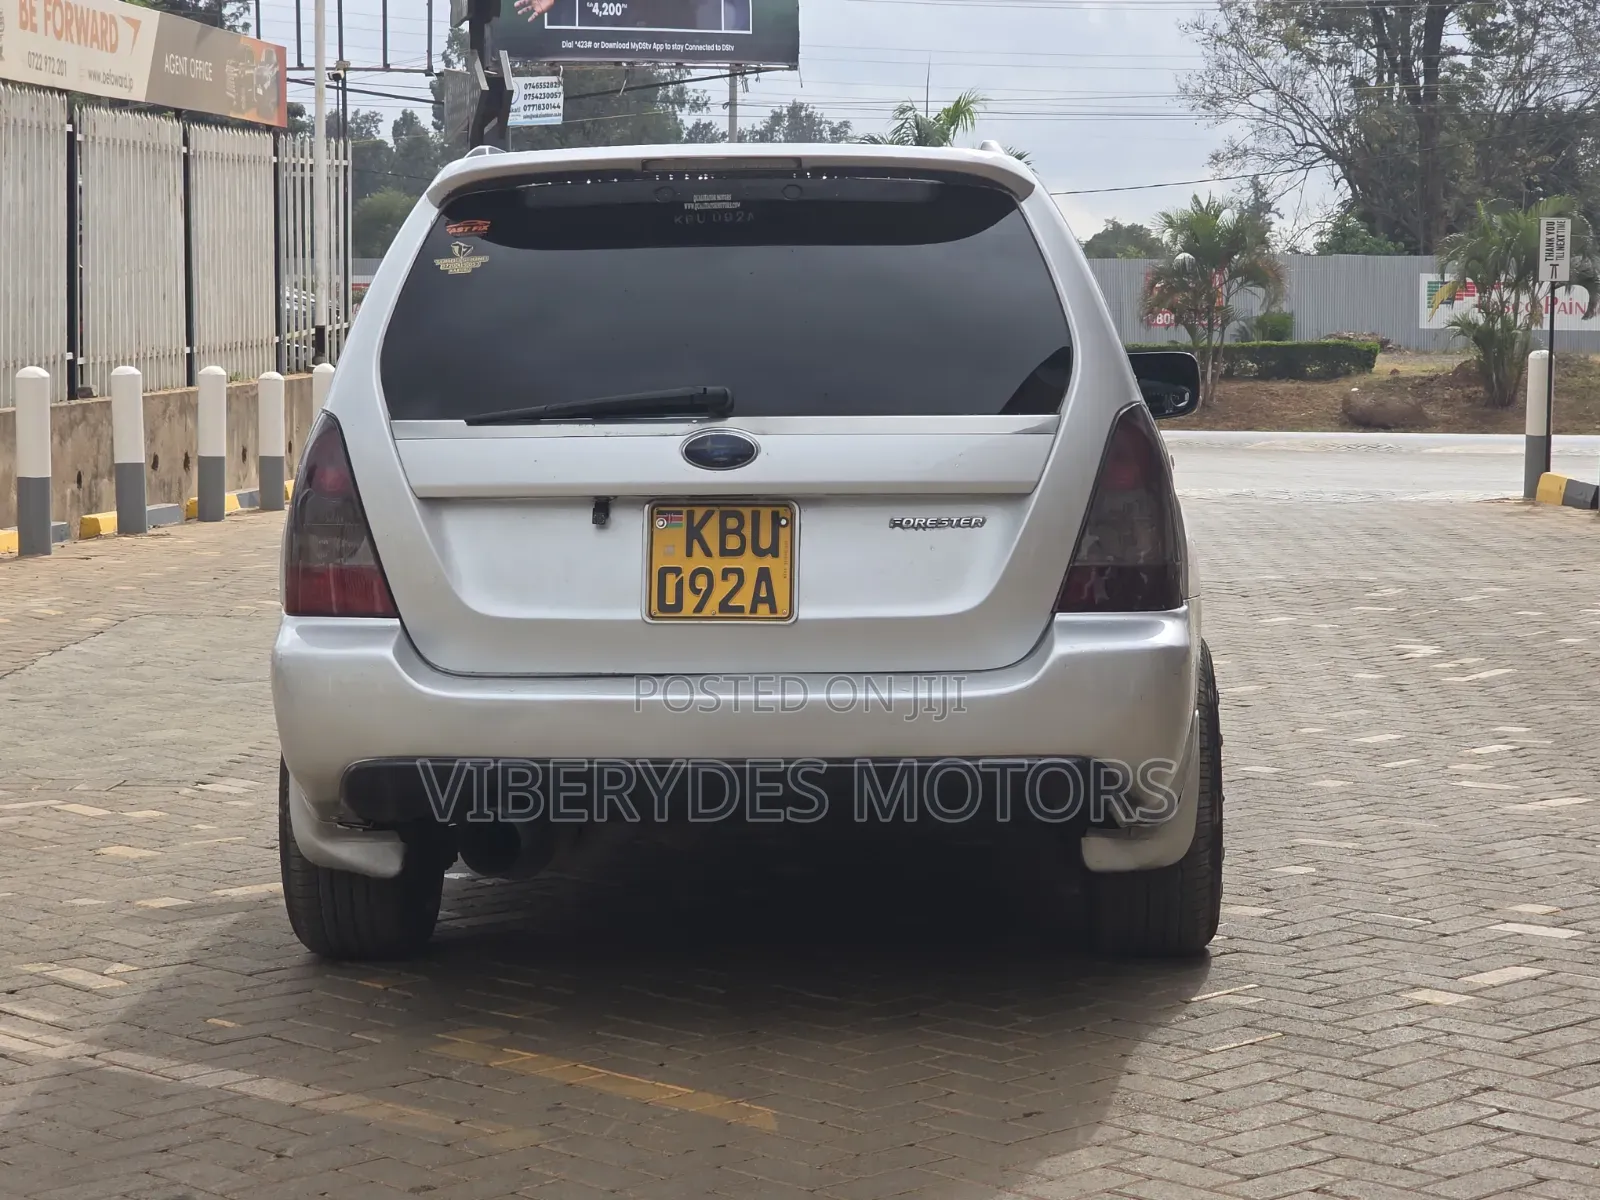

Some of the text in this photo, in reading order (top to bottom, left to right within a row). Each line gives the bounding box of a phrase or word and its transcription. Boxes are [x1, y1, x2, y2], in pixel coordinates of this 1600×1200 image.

[18, 0, 38, 34] BE
[44, 0, 119, 54] FORWARD
[591, 2, 622, 17] 4,200
[561, 40, 574, 48] Dial
[600, 41, 630, 49] Download
[630, 41, 652, 51] MyDStv
[652, 42, 664, 52] App
[664, 42, 671, 50] to
[671, 43, 684, 52] stay
[684, 43, 715, 51] Connected
[715, 43, 722, 51] to
[722, 43, 735, 52] DStv
[27, 50, 43, 72] 0722
[56, 57, 68, 78] 201
[164, 53, 213, 82] AGENT OFFICE
[1544, 221, 1556, 262] THANK YOU
[1556, 220, 1566, 261] TILL NEXT TIME
[685, 509, 780, 558] KBU
[889, 516, 986, 530] FORESTER
[657, 566, 778, 614] 092A
